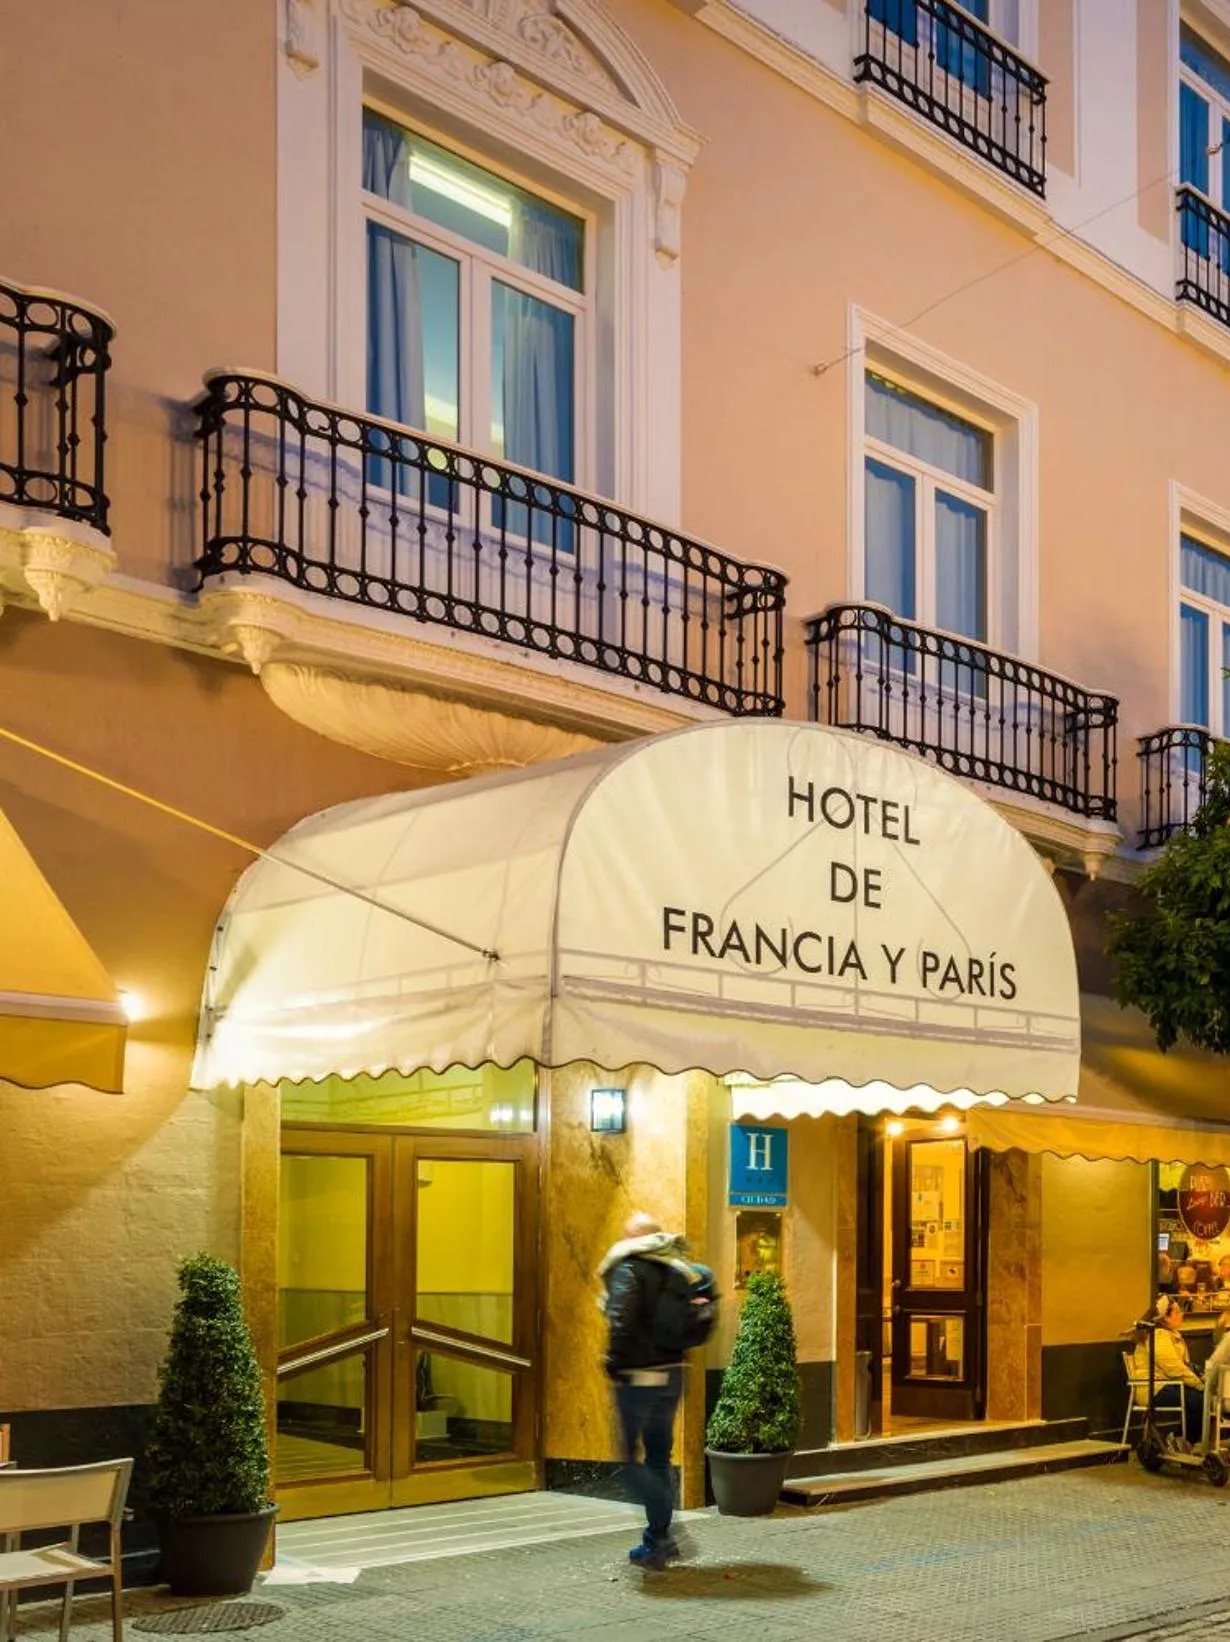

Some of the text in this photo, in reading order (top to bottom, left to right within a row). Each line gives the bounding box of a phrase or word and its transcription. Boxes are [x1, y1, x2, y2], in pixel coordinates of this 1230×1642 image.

[788, 776, 920, 846] HOTEL
[831, 861, 882, 909] DE
[663, 906, 1017, 1000] FRANCIA Y PARÍS
[745, 1133, 775, 1171] H
